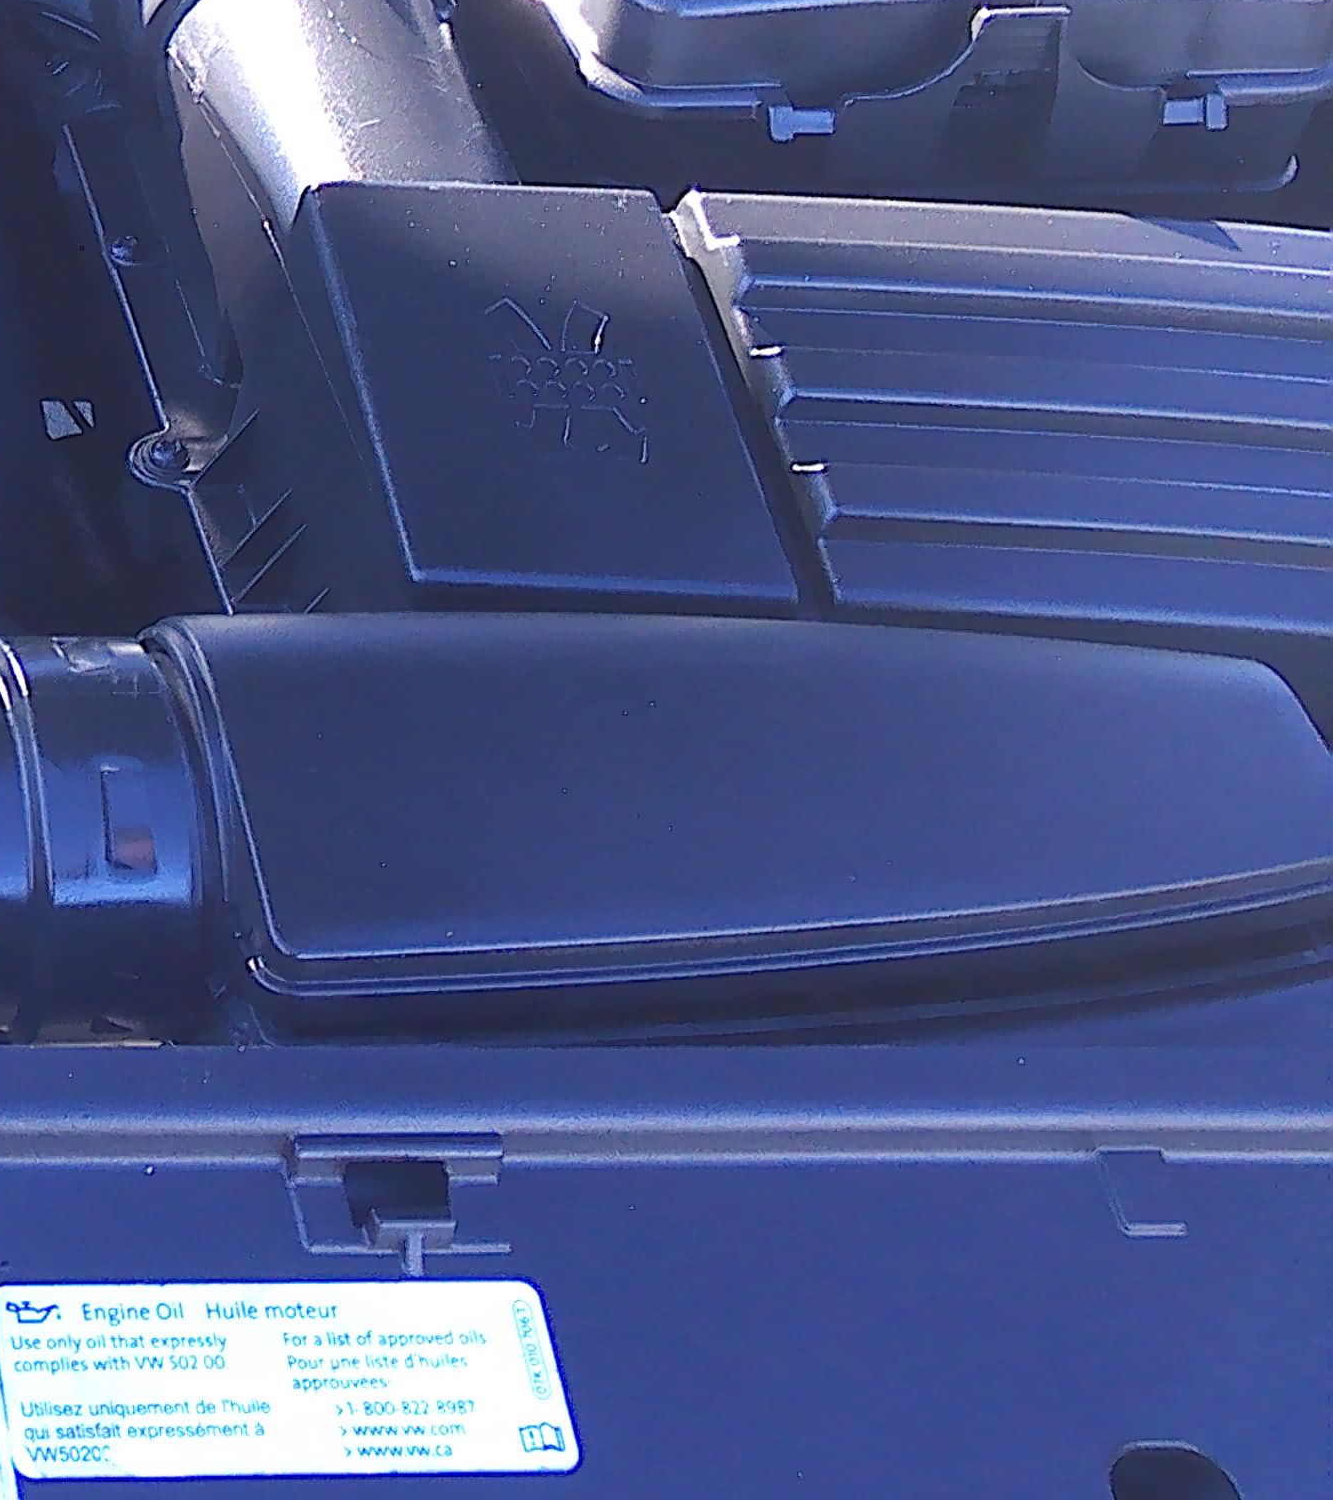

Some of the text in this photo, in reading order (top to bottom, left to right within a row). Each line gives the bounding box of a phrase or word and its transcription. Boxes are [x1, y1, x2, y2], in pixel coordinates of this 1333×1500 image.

[82, 1302, 184, 1327] Engine Oil
[206, 1303, 338, 1320] Huile moteur
[10, 1333, 227, 1355] Use only oil that expressly
[283, 1331, 308, 1347] For
[314, 1335, 322, 1347] a
[326, 1332, 350, 1347] list
[356, 1330, 372, 1347] of
[378, 1331, 454, 1349] approved
[13, 1357, 89, 1377] complies
[92, 1356, 130, 1373] with
[134, 1355, 164, 1371] VW
[169, 1354, 198, 1371] 502
[20, 1398, 271, 1419] Utilisez uniquement de l'huile
[24, 1423, 50, 1444] qui
[55, 1421, 121, 1442] satisfait
[254, 1421, 265, 1437] à
